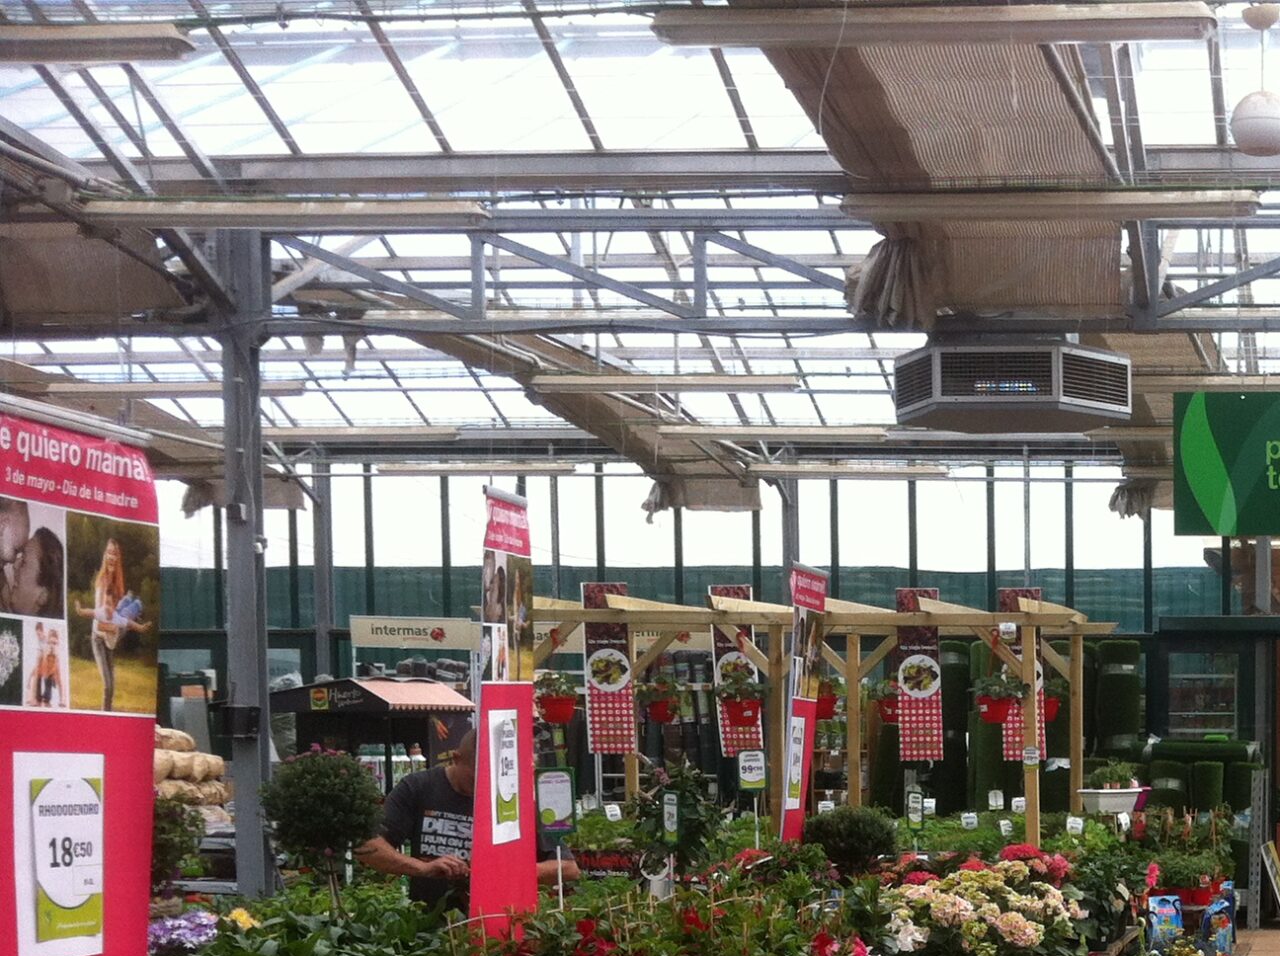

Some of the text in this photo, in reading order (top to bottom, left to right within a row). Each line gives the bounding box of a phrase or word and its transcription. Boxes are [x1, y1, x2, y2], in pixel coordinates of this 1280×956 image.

[17, 430, 81, 466] quiero
[12, 471, 25, 485] de
[27, 474, 55, 493] mayo
[62, 479, 77, 497] Día
[79, 484, 92, 499] de
[94, 487, 104, 501] la
[105, 492, 139, 508] madre
[371, 623, 429, 636] intermas
